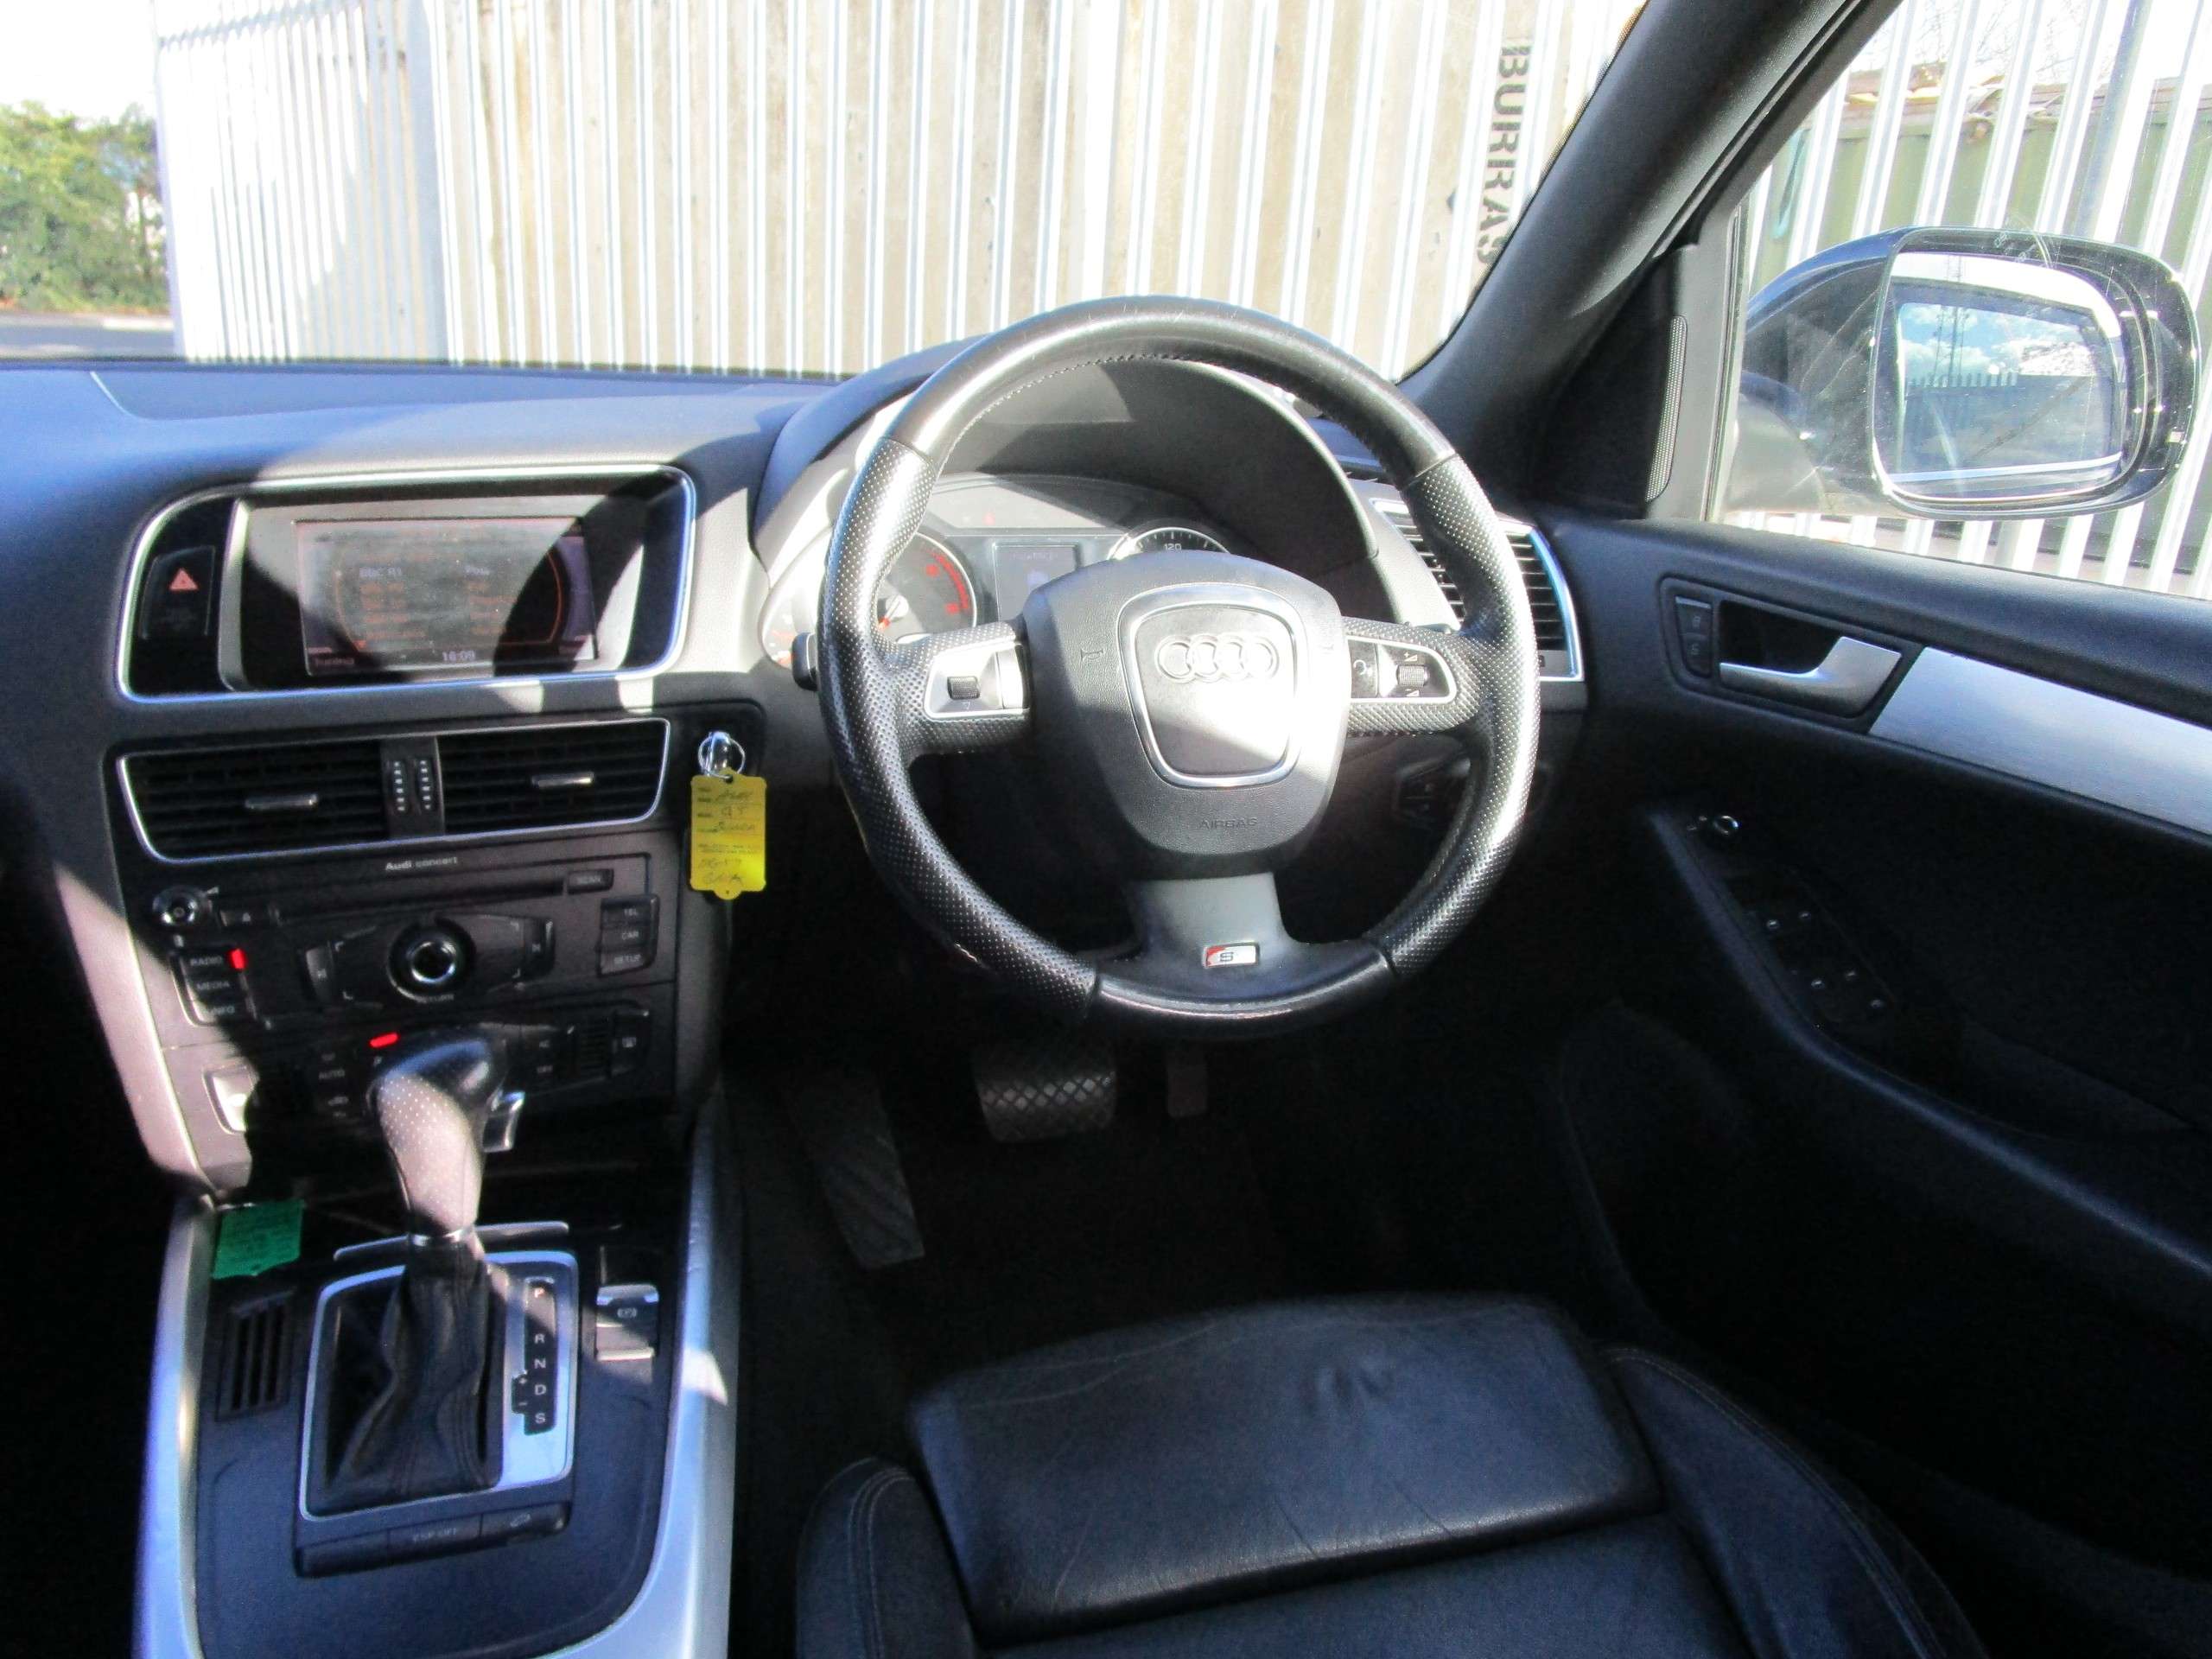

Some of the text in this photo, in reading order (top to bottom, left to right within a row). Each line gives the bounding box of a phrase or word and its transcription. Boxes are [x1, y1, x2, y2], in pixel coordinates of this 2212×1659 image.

[1476, 45, 1531, 264] BURRAS
[1163, 543, 1182, 552] 120
[1199, 817, 1257, 830] AIRBAG
[385, 857, 458, 871] Audi concert
[622, 931, 639, 940] CAR
[190, 956, 222, 966] RADIO
[196, 980, 230, 990] MEDIA
[318, 1070, 346, 1080] AUTO
[534, 1333, 545, 1344] R
[534, 1359, 546, 1369] N
[534, 1384, 547, 1395] D
[535, 1412, 546, 1424] S
